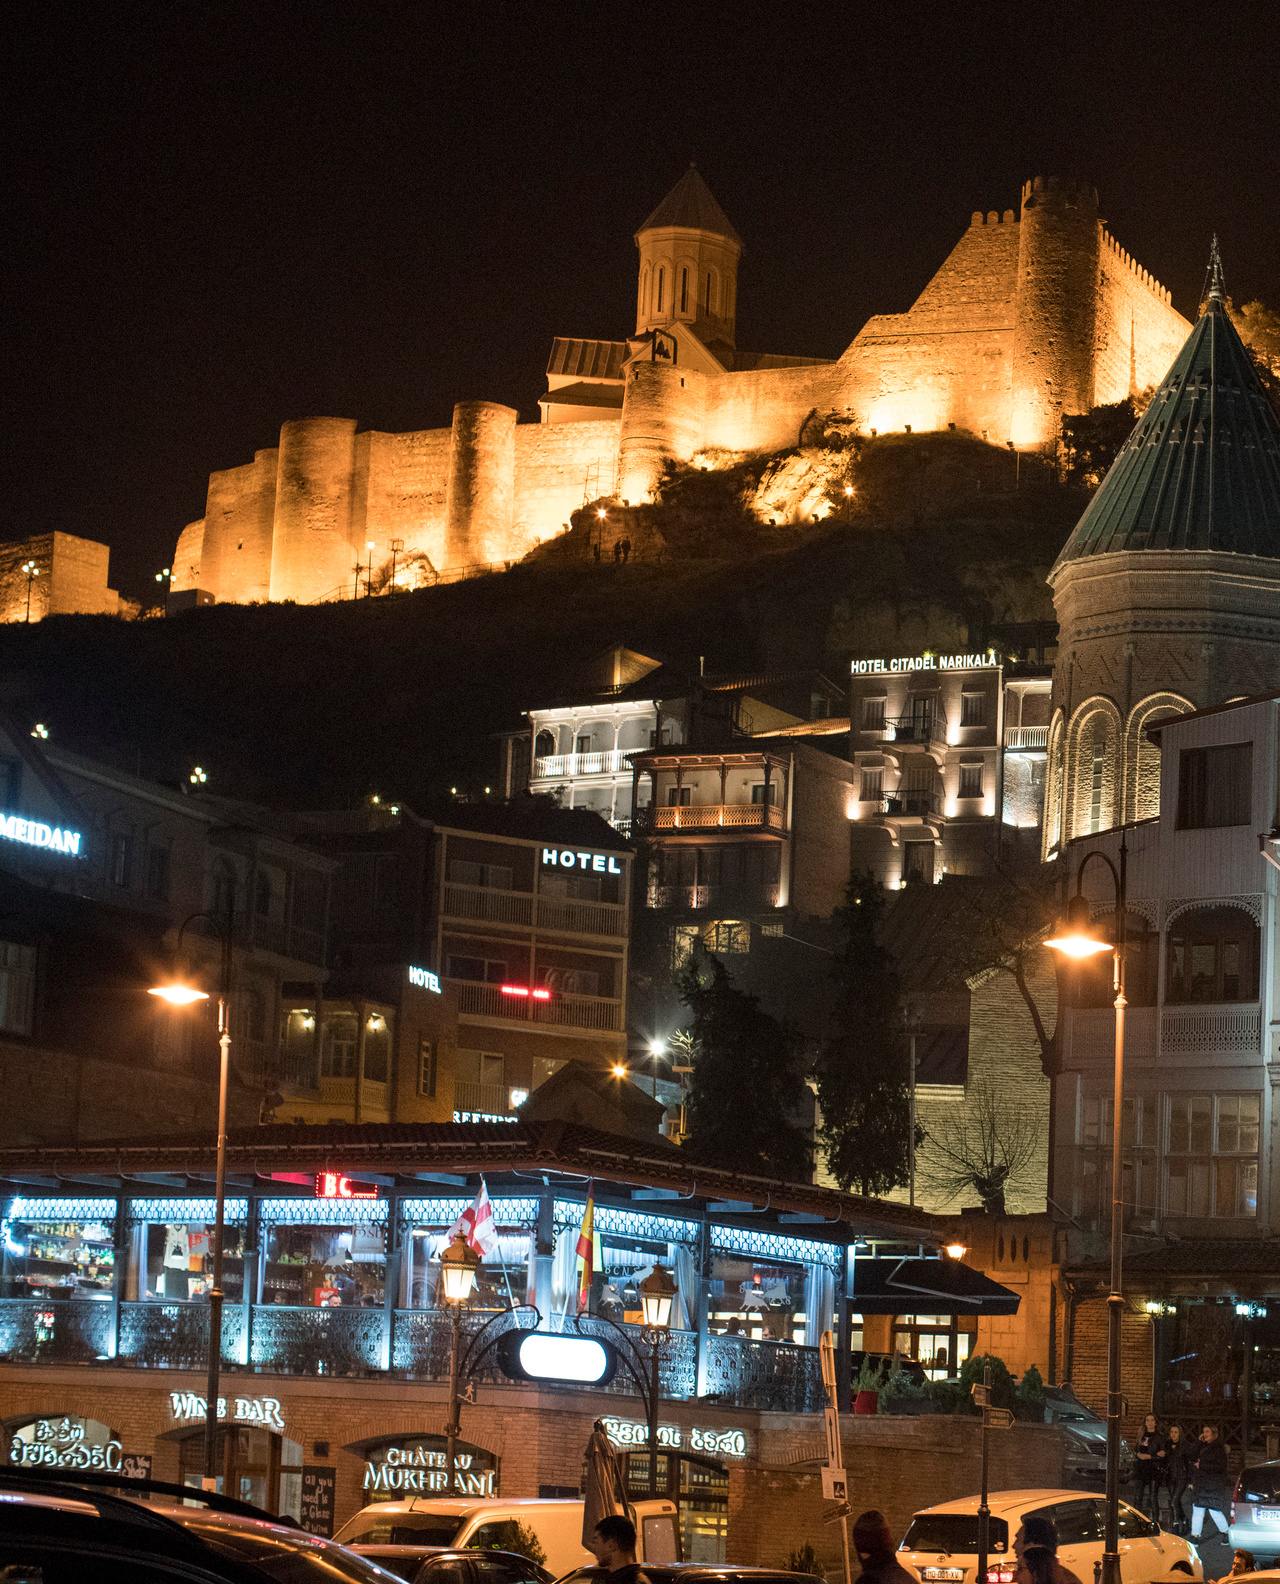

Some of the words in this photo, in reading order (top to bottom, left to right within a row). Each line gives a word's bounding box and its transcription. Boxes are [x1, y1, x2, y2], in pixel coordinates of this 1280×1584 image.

[851, 659, 888, 674] HOTEL
[890, 656, 937, 672] CITADEL
[939, 653, 997, 669] NARIKALA
[0, 813, 81, 855] MEIDAN
[542, 848, 621, 874] HOTEL
[409, 965, 442, 994] HOTEL
[234, 1397, 285, 1428] BAR
